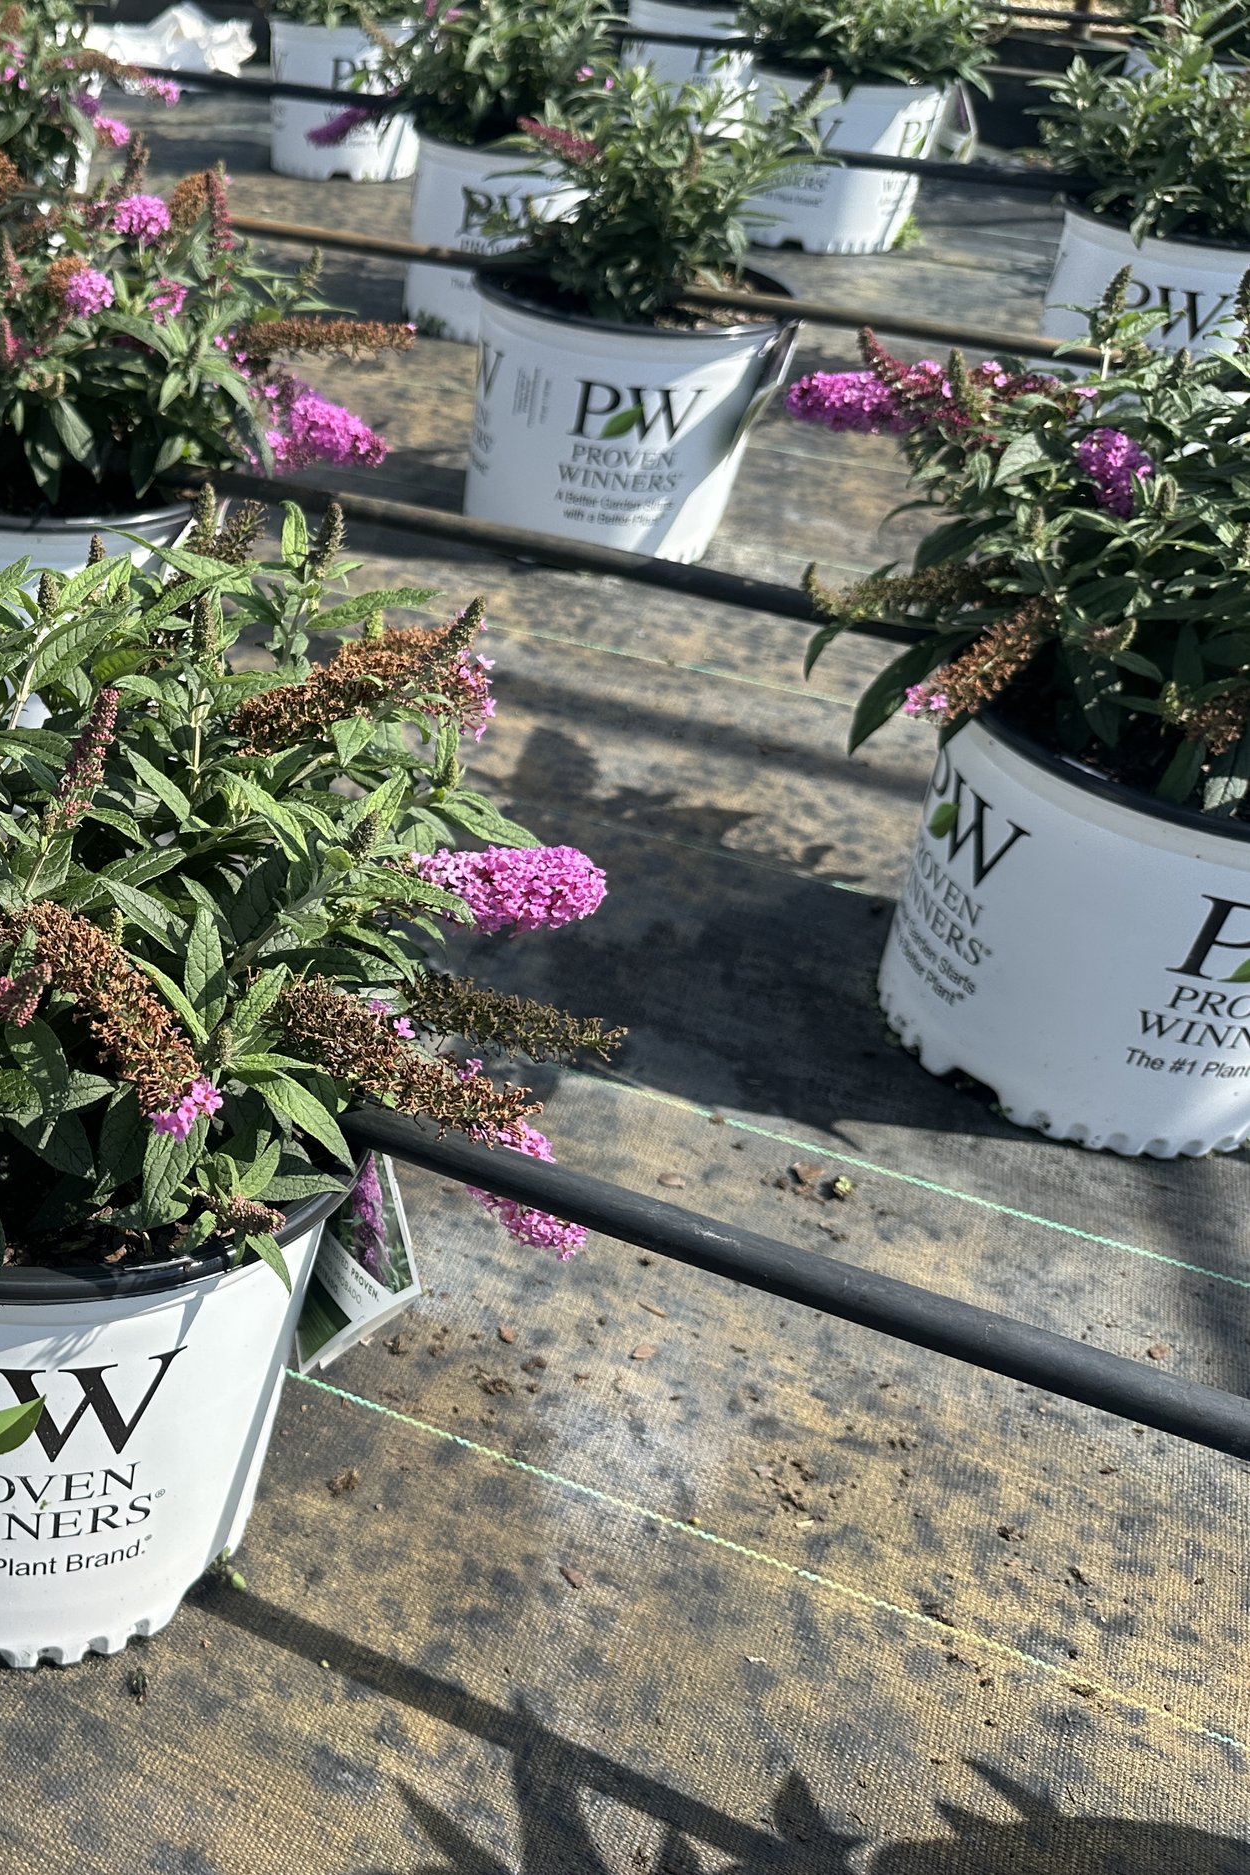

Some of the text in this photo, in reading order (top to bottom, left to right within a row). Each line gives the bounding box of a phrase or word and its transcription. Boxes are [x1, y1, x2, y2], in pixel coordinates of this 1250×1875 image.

[566, 377, 710, 444] PW
[571, 442, 679, 470] PROVEN
[1125, 1046, 1165, 1071] The
[1169, 1058, 1198, 1077] #1
